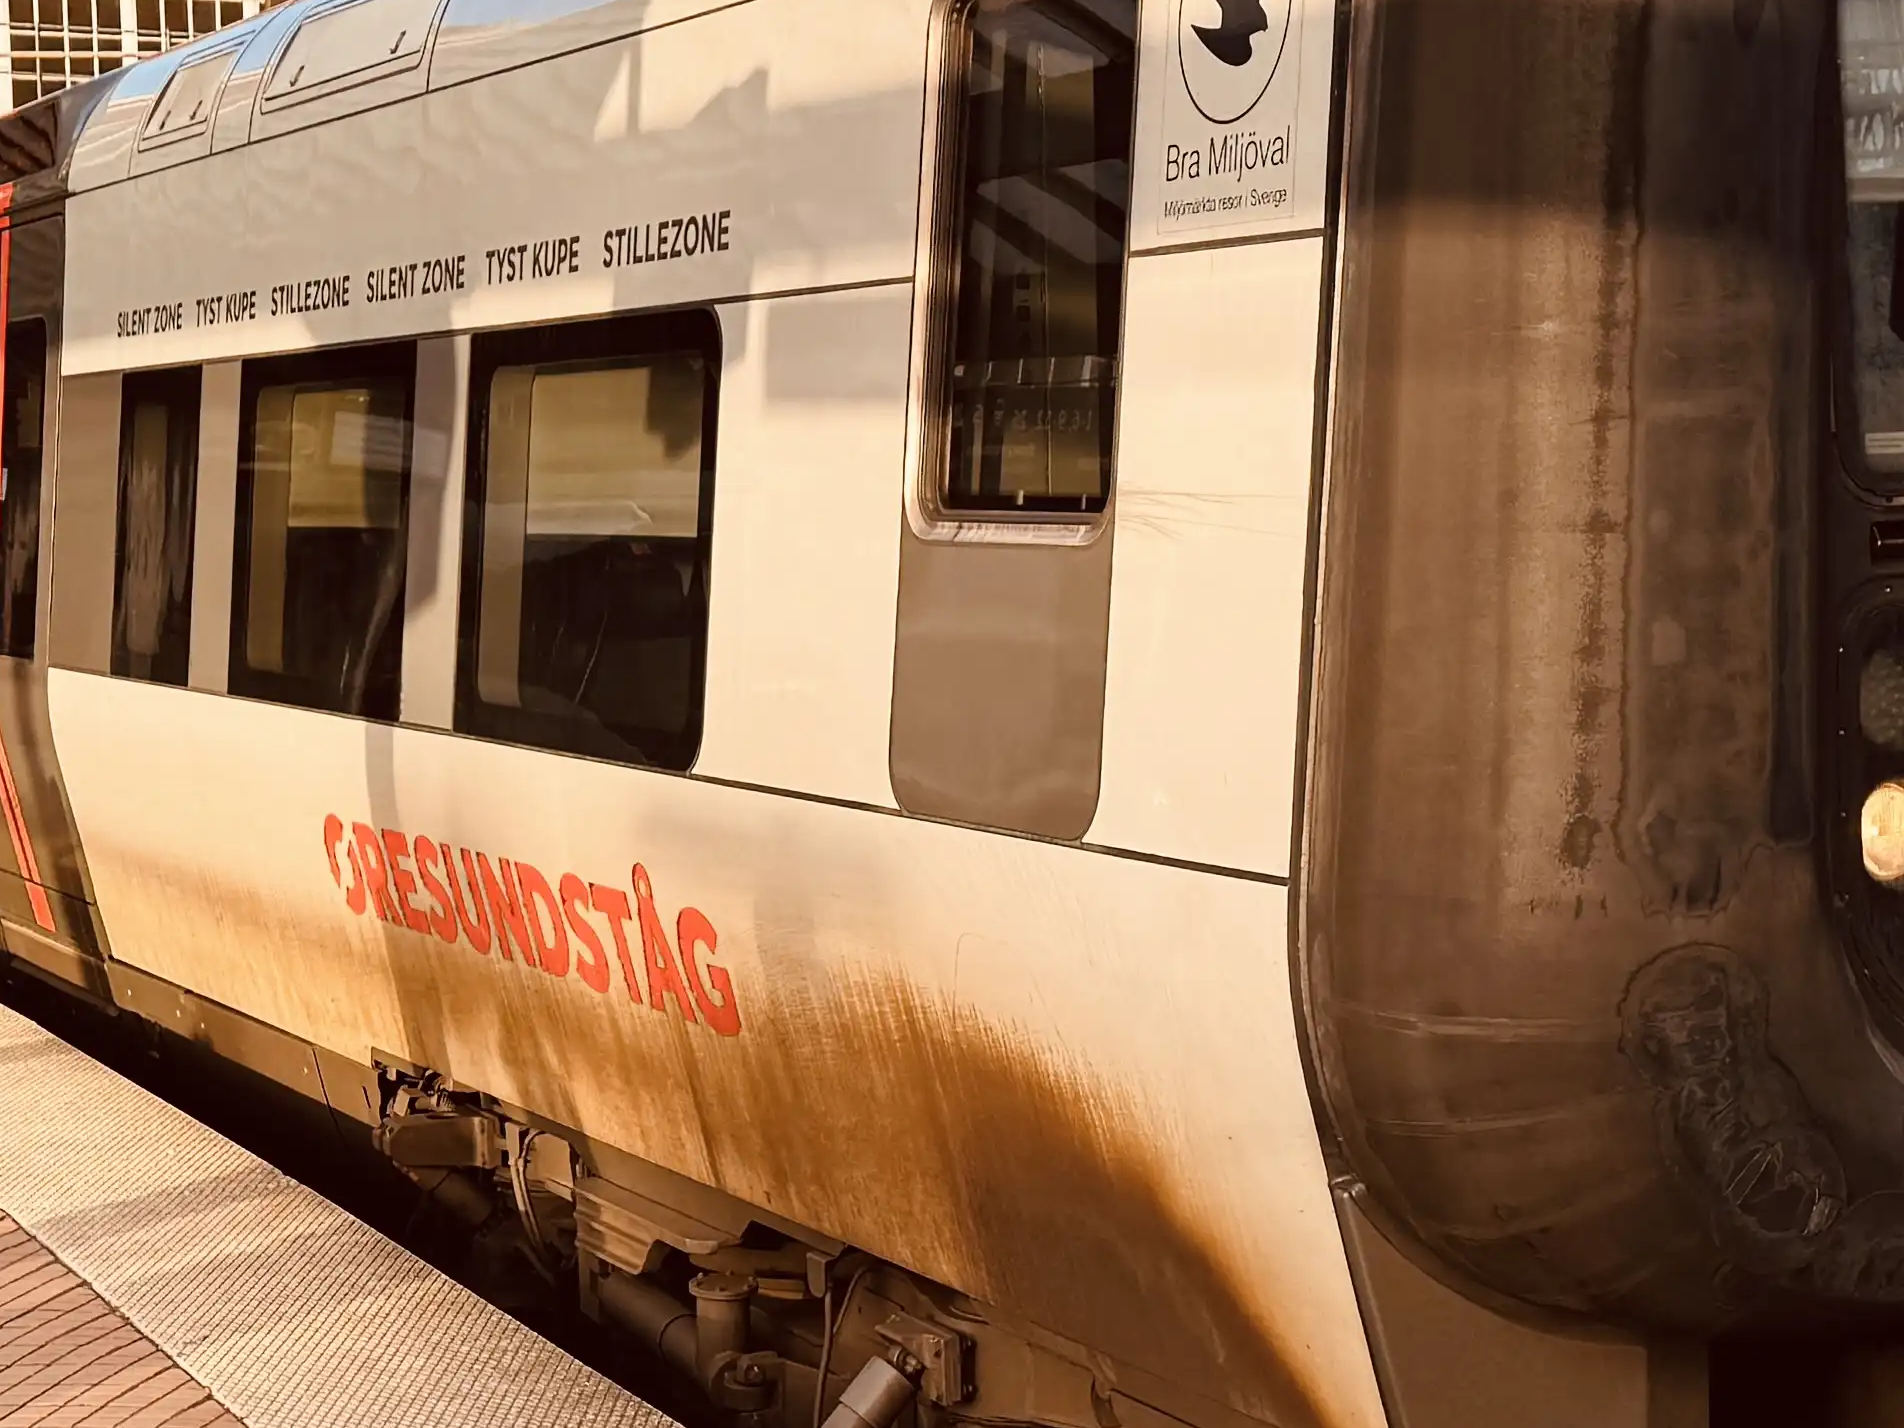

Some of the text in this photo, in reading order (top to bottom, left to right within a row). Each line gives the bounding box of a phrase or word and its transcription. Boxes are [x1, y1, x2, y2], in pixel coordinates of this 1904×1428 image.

[1166, 124, 1291, 183] Bra Miljöval
[117, 210, 731, 338] SILENT ZONE TYST KUPE STILLEZONE SILENT ZONE TYST KUPE STILLEZONE
[323, 812, 743, 1038] ØRESUNDSTÅG
